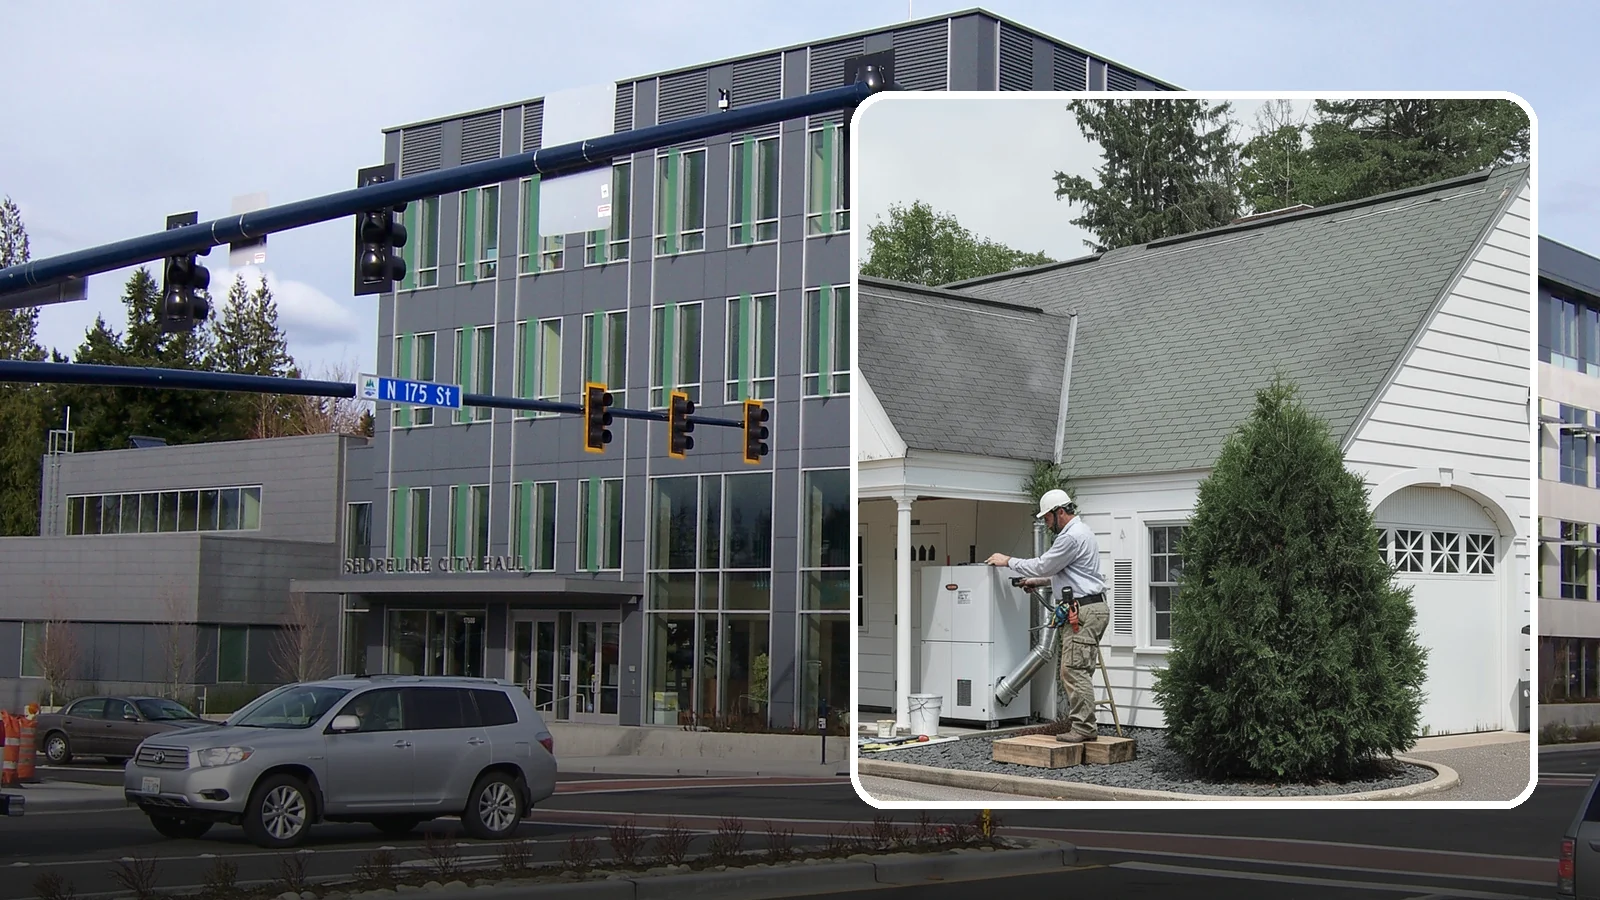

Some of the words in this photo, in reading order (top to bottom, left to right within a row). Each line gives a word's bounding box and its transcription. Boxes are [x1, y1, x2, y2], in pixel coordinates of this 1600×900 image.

[387, 380, 396, 399] N
[405, 383, 428, 402] 175
[436, 386, 451, 405] St
[344, 556, 431, 573] SHORELINE
[438, 556, 474, 572] CITY
[483, 555, 525, 572] HALL
